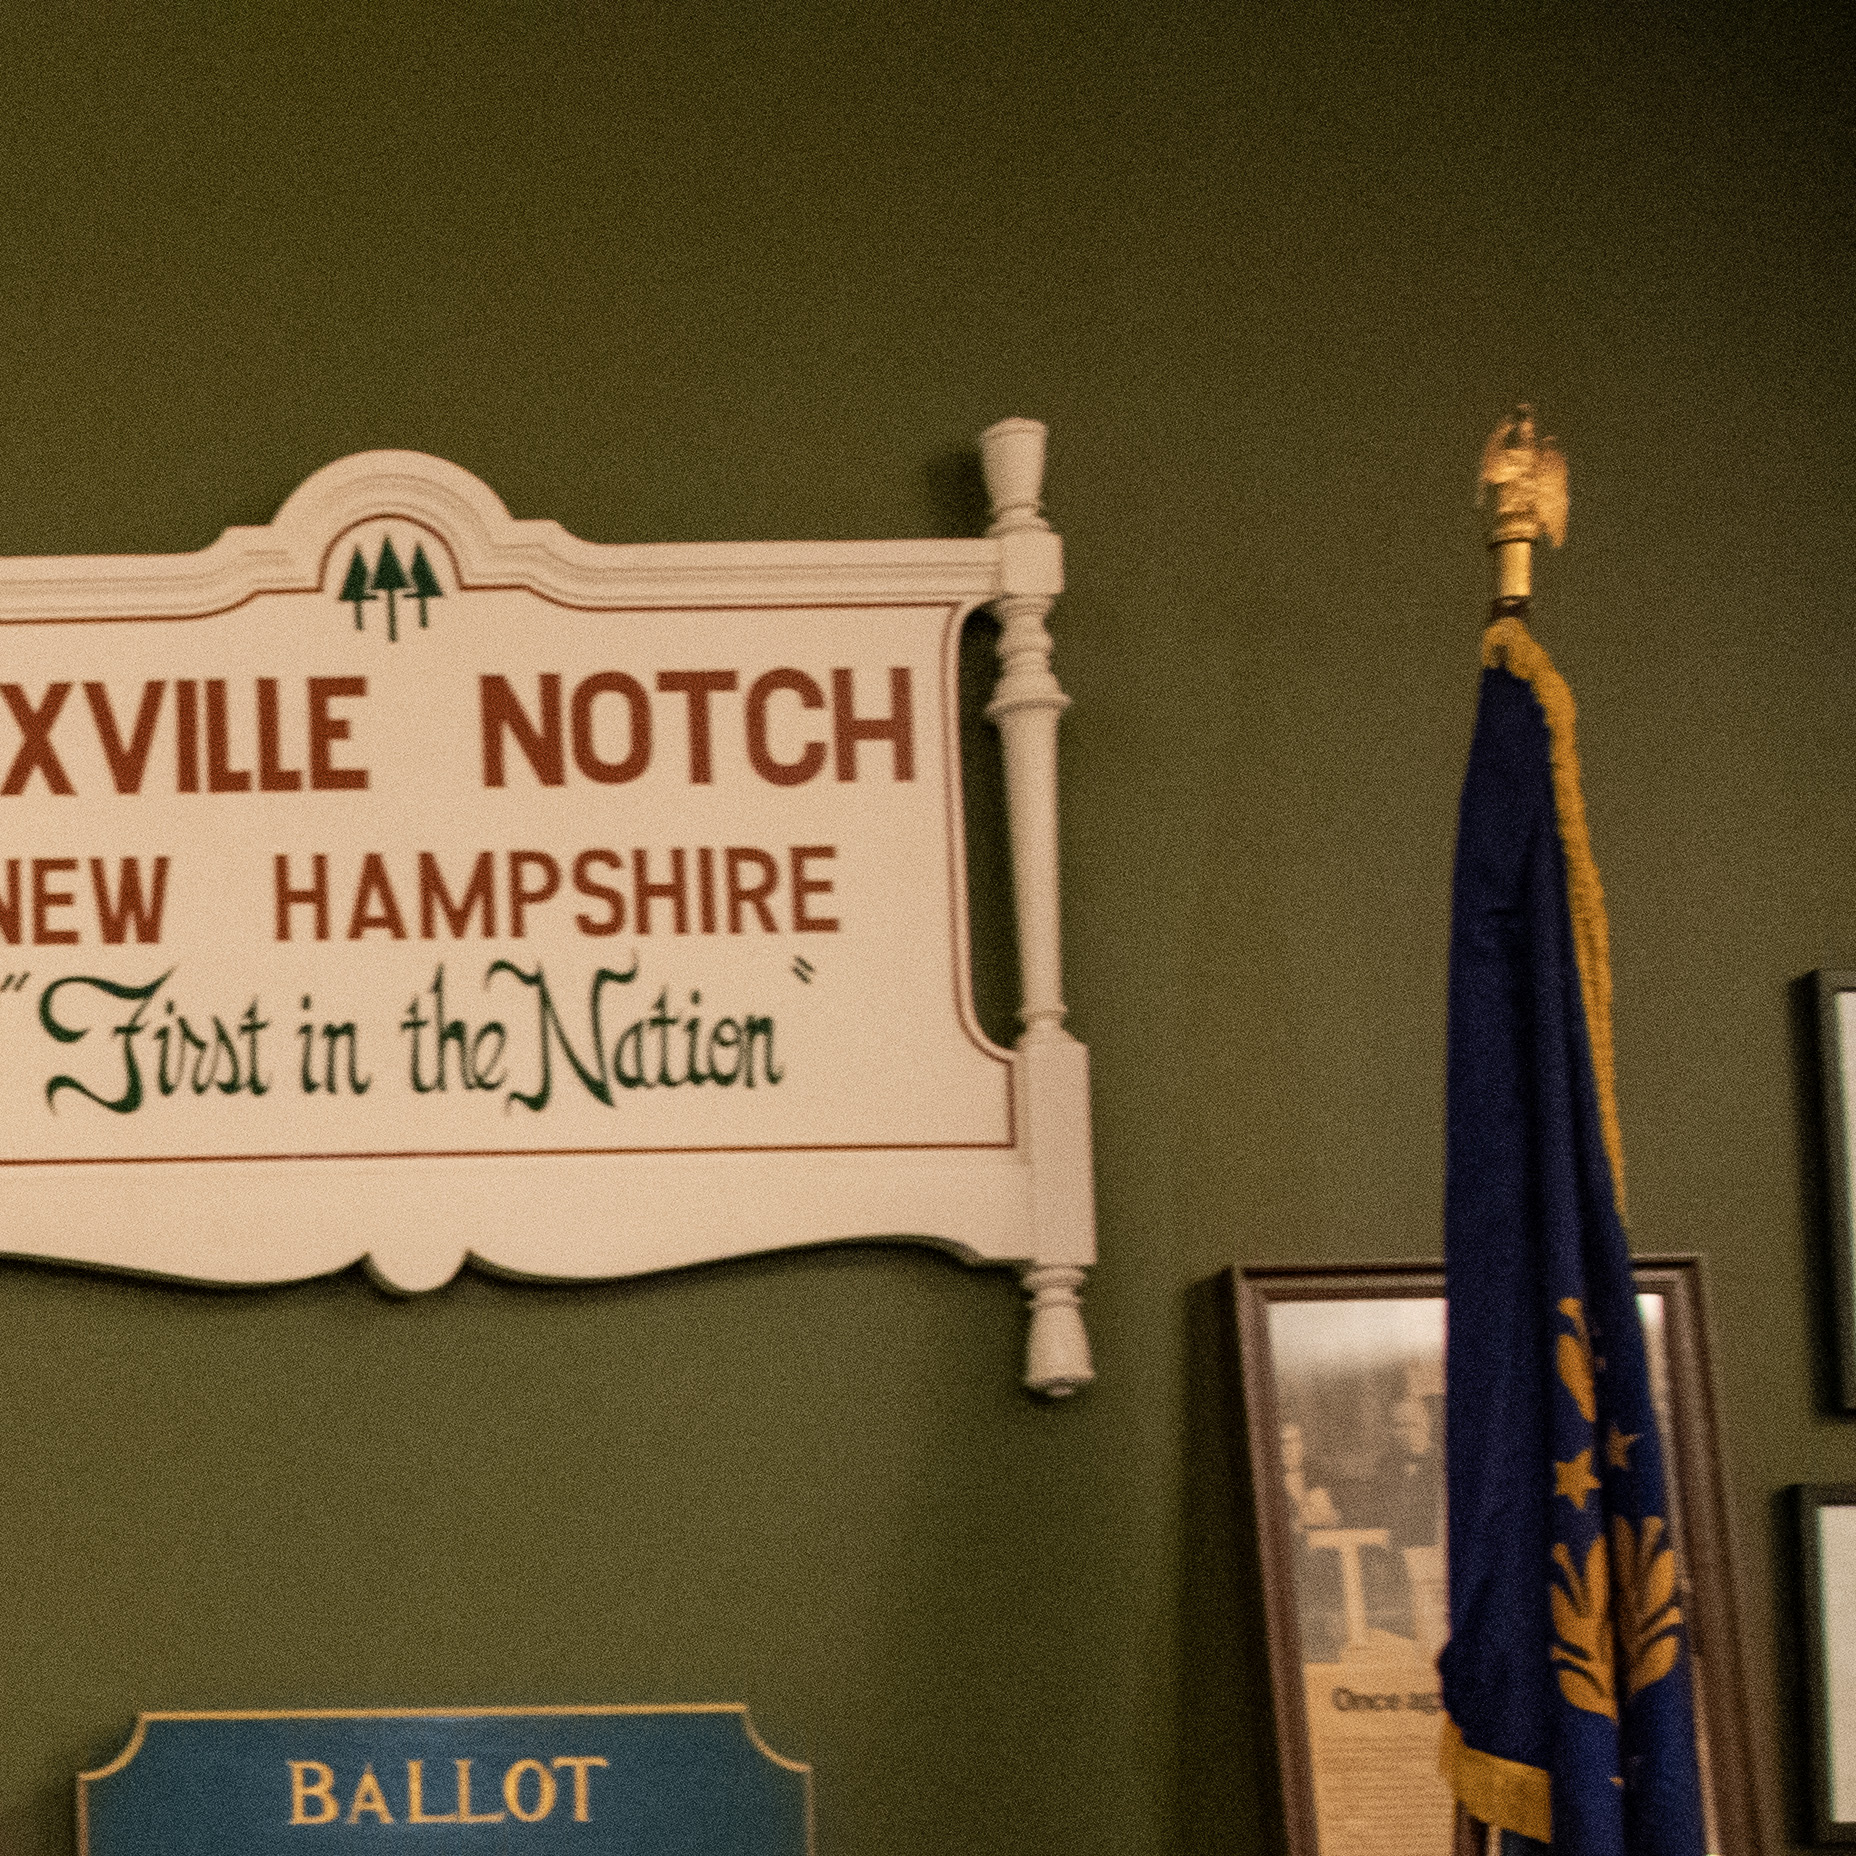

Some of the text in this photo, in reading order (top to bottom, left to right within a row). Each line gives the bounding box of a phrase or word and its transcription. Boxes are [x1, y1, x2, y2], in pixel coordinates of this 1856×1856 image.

[478, 665, 916, 788] NOTCH
[273, 845, 841, 942] HAMPSHIRE
[298, 995, 371, 1096] in
[400, 963, 510, 1094] the
[287, 1755, 610, 1827] BALLOT
